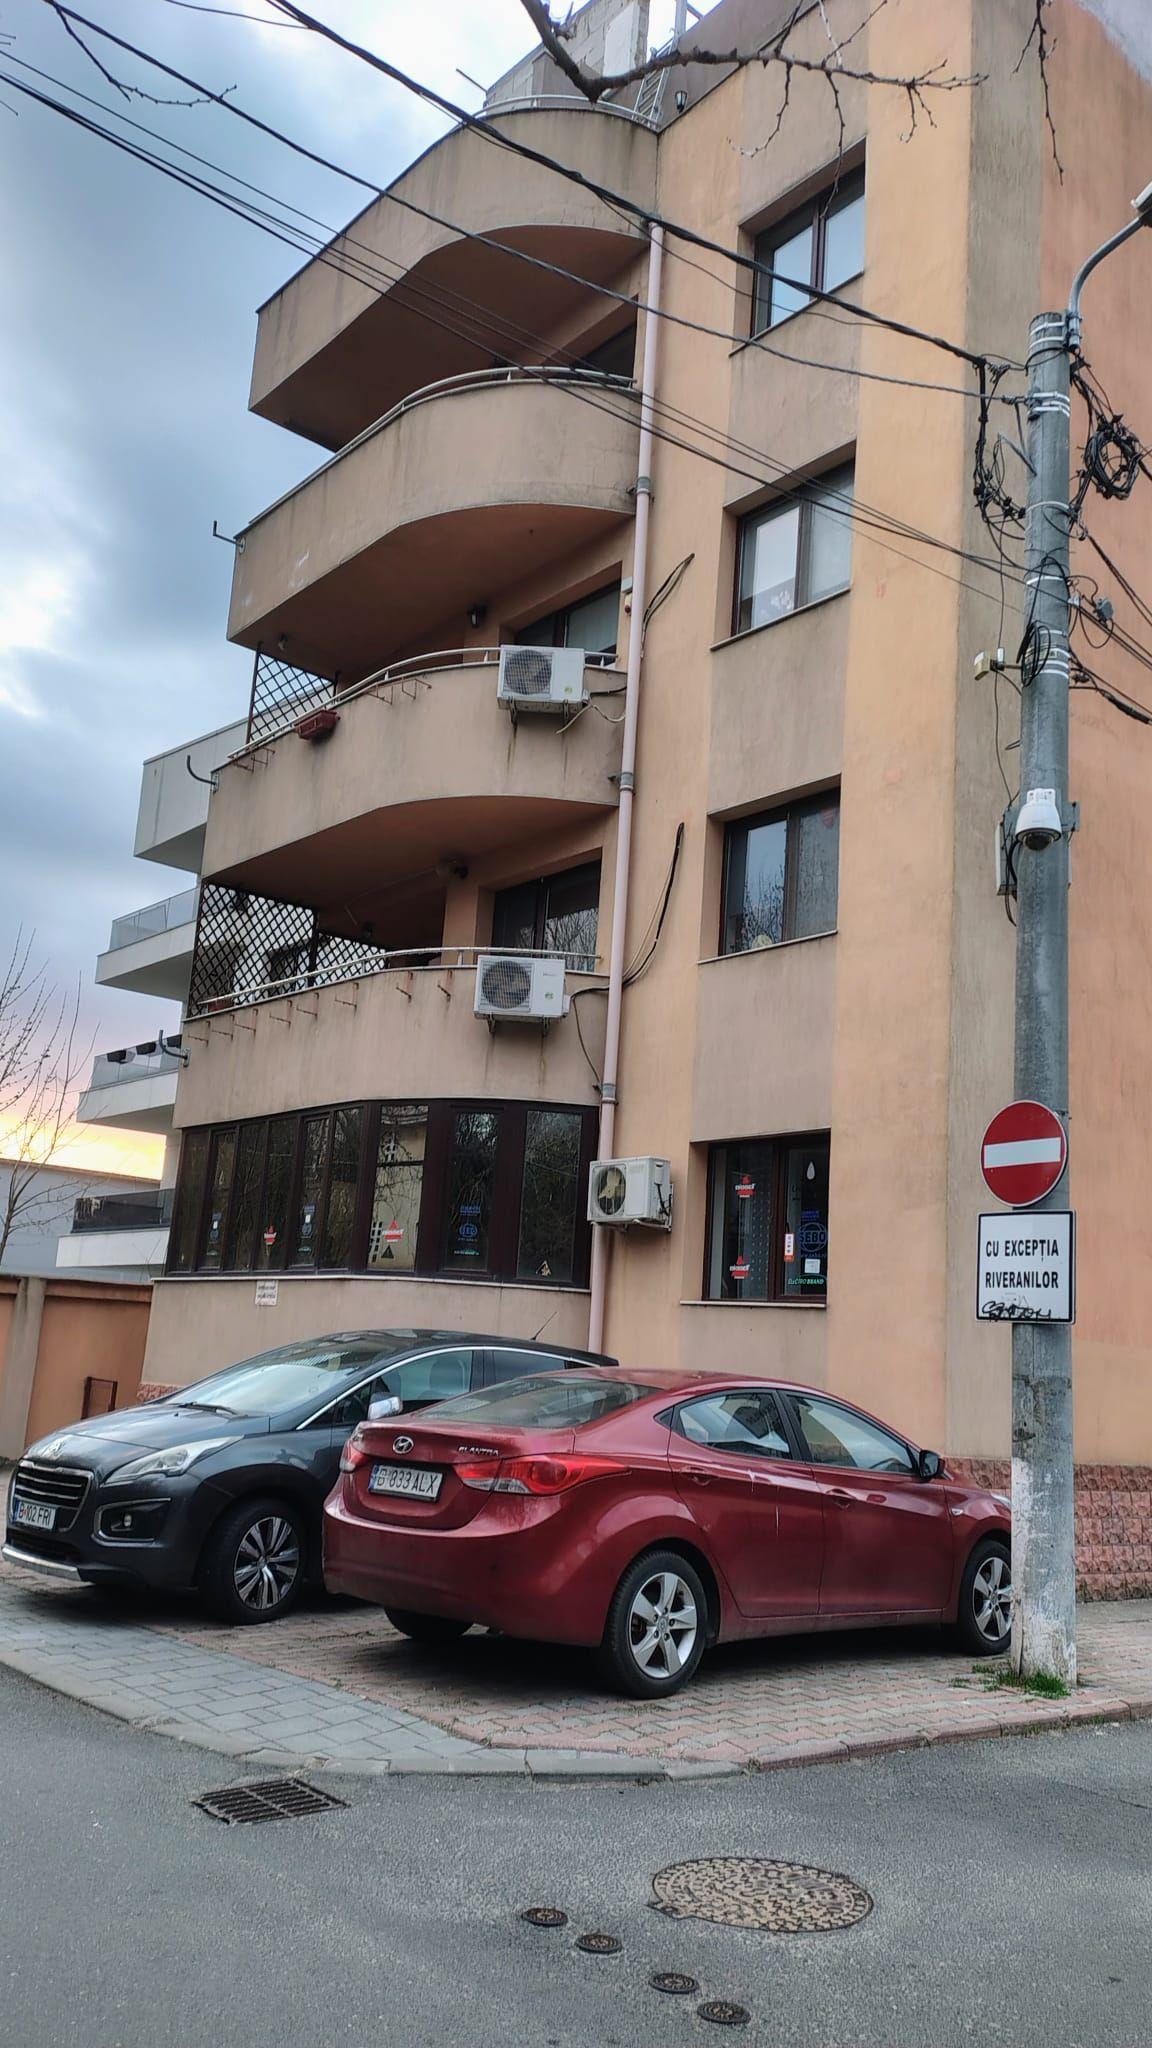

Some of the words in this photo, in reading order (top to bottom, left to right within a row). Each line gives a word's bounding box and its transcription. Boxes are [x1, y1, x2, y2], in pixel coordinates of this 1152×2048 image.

[799, 1231, 826, 1243] SEBO
[985, 1240, 999, 1257] CU
[985, 1271, 1059, 1288] RIVERANILOR
[377, 1468, 388, 1486] B
[389, 1469, 412, 1490] 833
[412, 1472, 438, 1494] ALX
[19, 1501, 26, 1519] B
